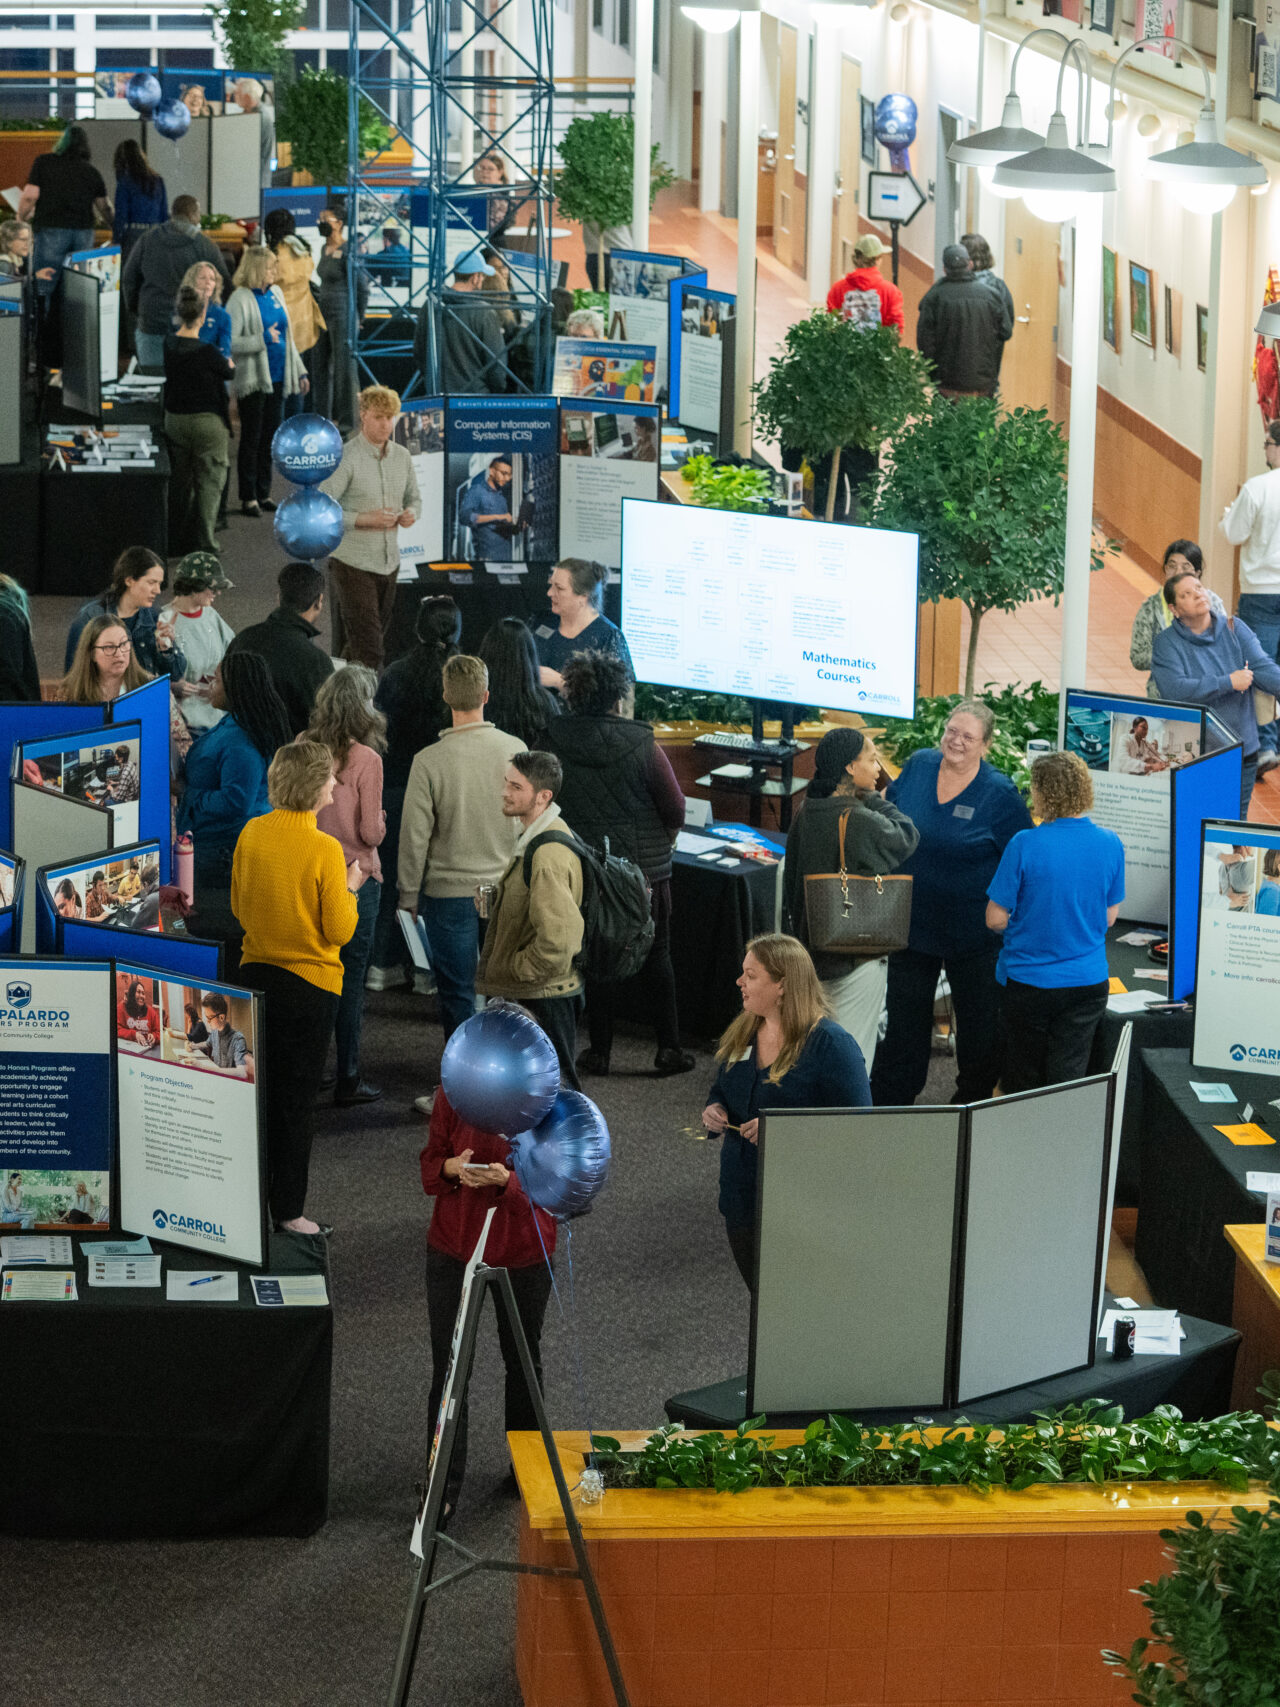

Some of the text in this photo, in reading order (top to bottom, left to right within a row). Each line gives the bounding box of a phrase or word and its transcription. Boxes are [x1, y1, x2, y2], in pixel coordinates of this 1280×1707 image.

[454, 420, 550, 430] Computer Information
[472, 431, 532, 441] Systems (CIS)
[285, 453, 336, 465] CARROLL
[802, 650, 877, 670] Mathematics
[817, 668, 861, 684] Courses
[141, 1072, 193, 1090] Program Objectives
[169, 1213, 226, 1237] CARROLL
[170, 1226, 226, 1244] COMMUNITY COLLEGE
